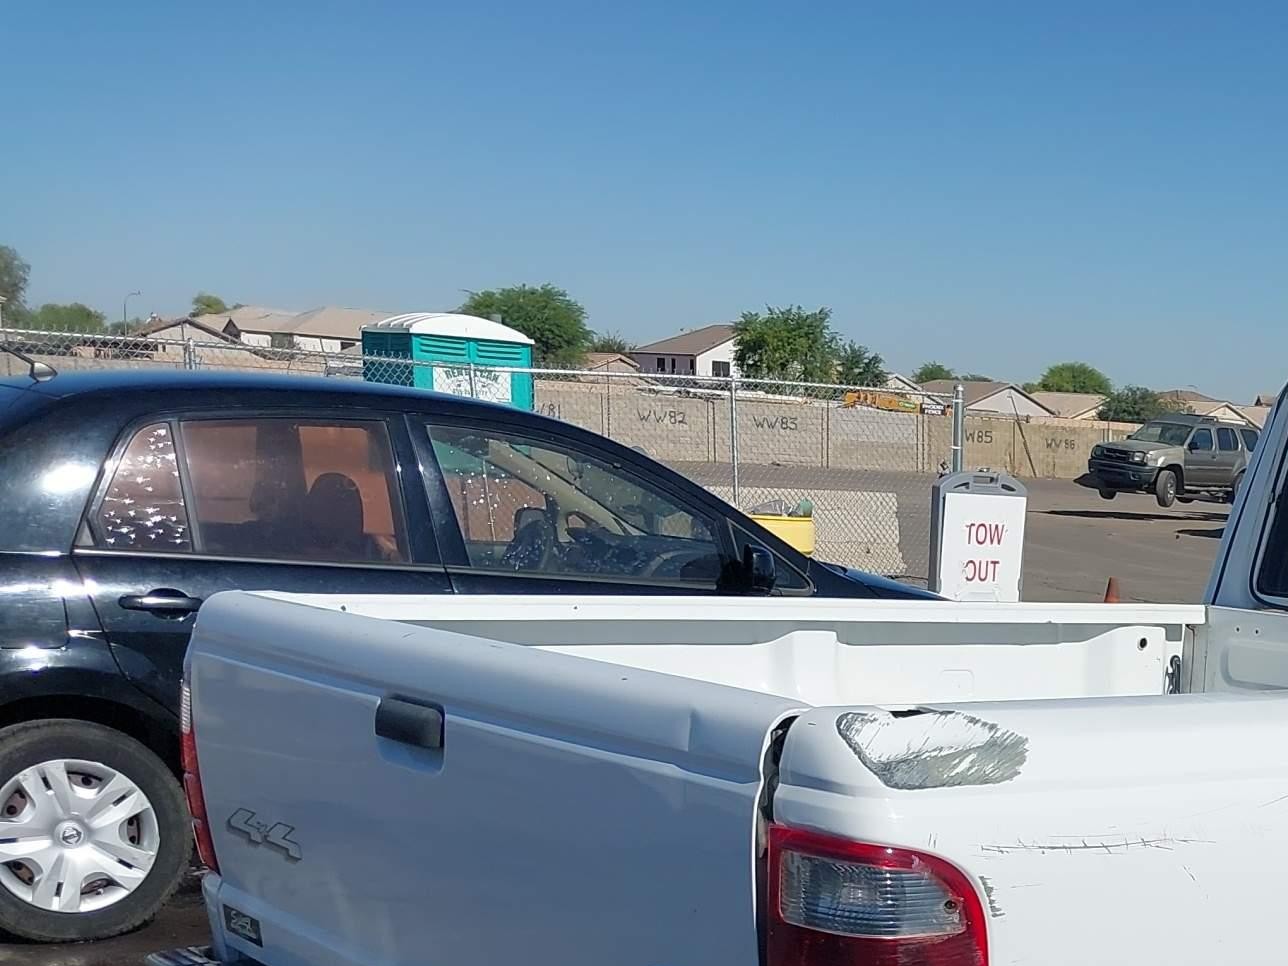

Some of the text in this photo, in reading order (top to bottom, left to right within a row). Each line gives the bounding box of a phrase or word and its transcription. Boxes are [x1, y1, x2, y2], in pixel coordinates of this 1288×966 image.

[637, 408, 688, 425] WW82
[752, 416, 798, 431] WW83
[965, 522, 1005, 545] TOW
[962, 559, 1000, 582] OUT
